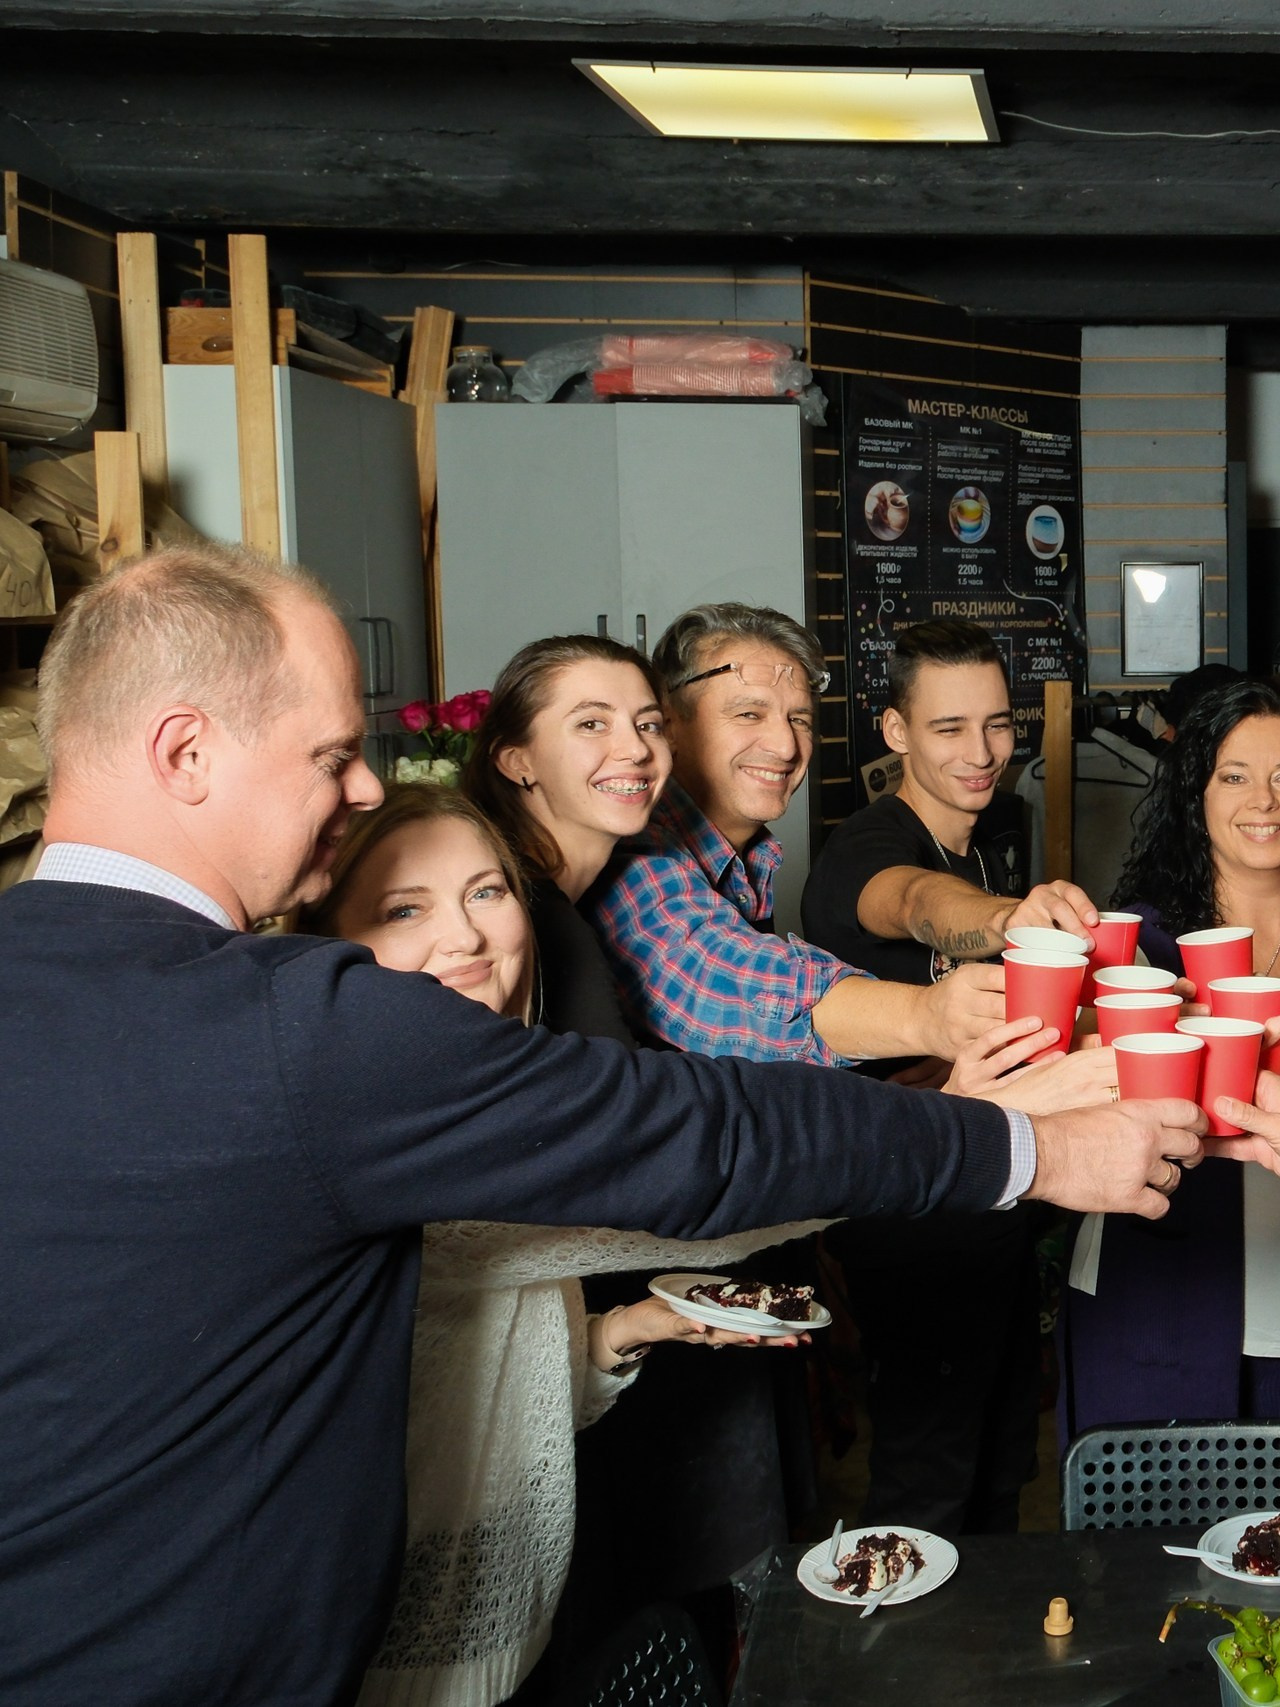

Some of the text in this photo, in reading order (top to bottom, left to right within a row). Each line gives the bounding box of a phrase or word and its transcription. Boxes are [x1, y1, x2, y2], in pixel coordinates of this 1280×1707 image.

[907, 398, 1028, 423] МАСТЕР-КЛАССЫ
[864, 417, 914, 429] БАЗОВЫЙ МК
[959, 425, 982, 435] МК №1
[859, 436, 892, 446] Гончарный
[892, 440, 905, 448] круг
[858, 444, 881, 452] ручная
[858, 459, 923, 471] Изделия без росписи
[937, 465, 961, 473] Роспись
[932, 601, 1016, 619] ПРАЗДНИКИ
[893, 621, 908, 631] ДНИ
[1000, 620, 1049, 629] КОРПОРАТИВЫ
[860, 641, 867, 651] С
[1027, 637, 1062, 647] С МК №1
[1021, 671, 1069, 681] С УЧАСТНИКА
